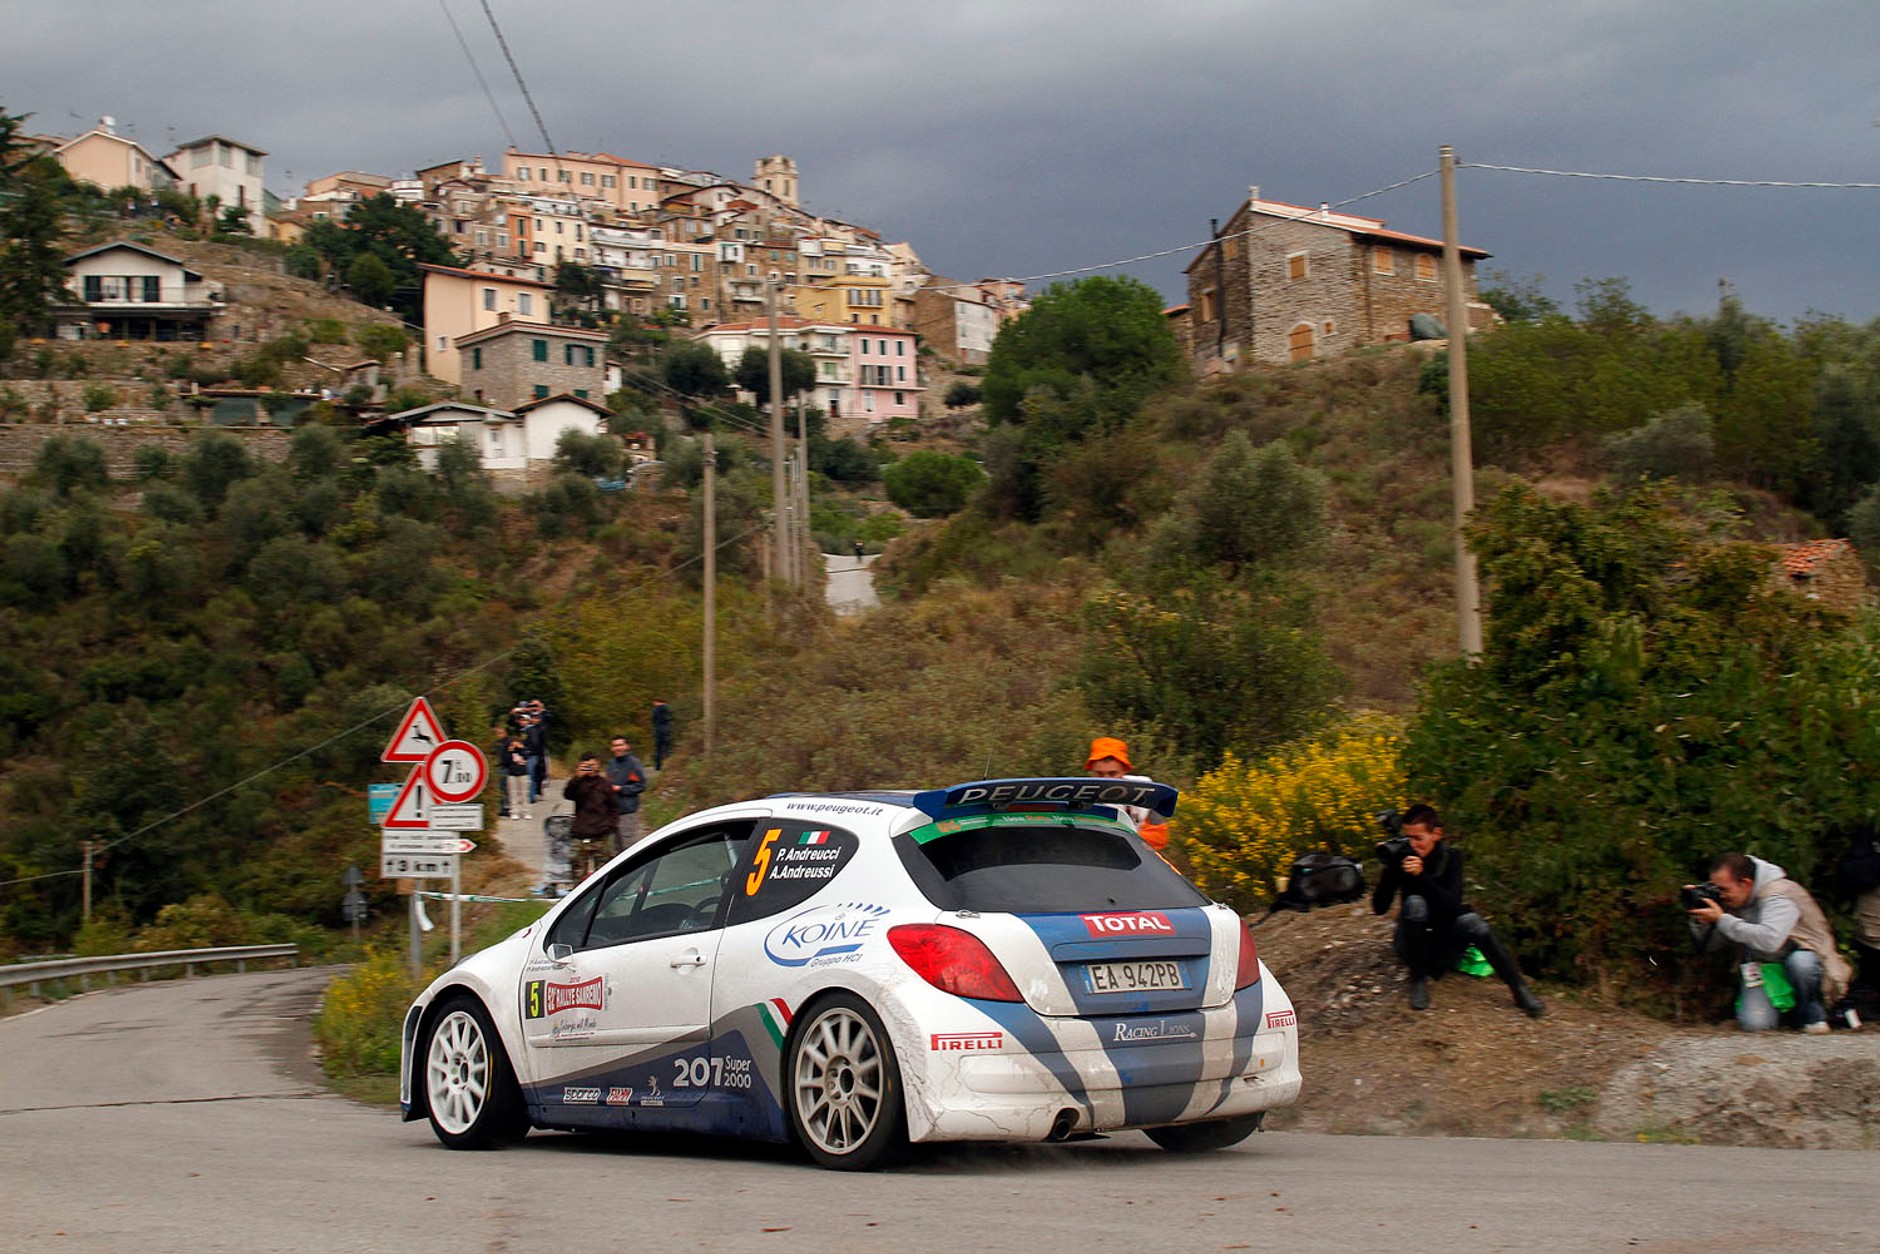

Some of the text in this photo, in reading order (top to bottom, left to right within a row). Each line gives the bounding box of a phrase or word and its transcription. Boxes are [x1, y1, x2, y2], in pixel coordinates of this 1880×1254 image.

[958, 785, 1156, 805] PEUGEOT
[787, 803, 884, 816] www.peugeot.it
[414, 860, 438, 872] km
[745, 828, 782, 896] 5
[769, 864, 835, 880] A.Andreussi
[1084, 916, 1171, 932] TOTAL
[810, 957, 842, 969] Gruppo
[1091, 963, 1180, 989] EA 942PB
[530, 982, 540, 1018] 5
[1266, 1010, 1295, 1028] PIRELLI
[930, 1031, 1003, 1051] PIRELLI
[673, 1057, 724, 1087] 207
[725, 1055, 752, 1074] Super
[724, 1073, 752, 1088] 2000
